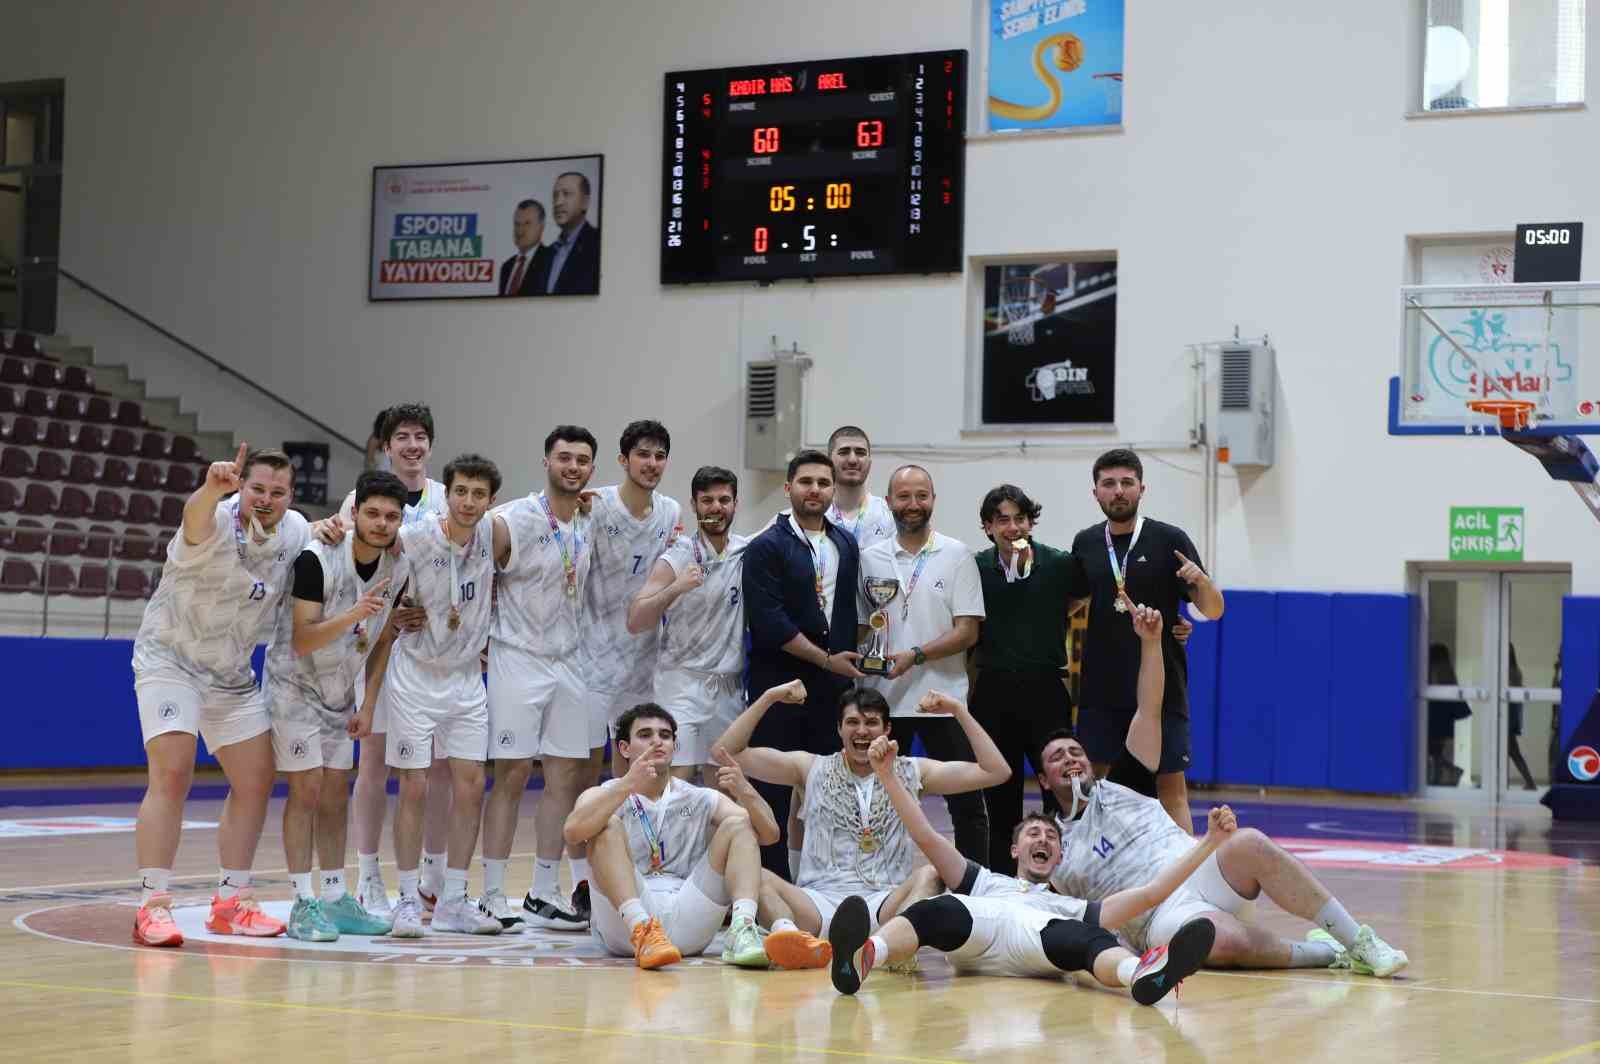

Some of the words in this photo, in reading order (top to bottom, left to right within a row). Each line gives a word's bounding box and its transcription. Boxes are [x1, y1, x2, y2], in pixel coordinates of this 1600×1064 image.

[914, 77, 924, 90] 2
[675, 137, 684, 149] 8
[753, 127, 779, 154] 60
[857, 121, 883, 147] 63
[913, 135, 922, 148] 8
[402, 215, 467, 235] SPORU
[755, 227, 768, 253] 0
[803, 225, 816, 251] 5
[1525, 229, 1570, 245] 05:00
[396, 239, 475, 259] TABANA
[384, 262, 492, 281] YAYIYORUZ
[632, 555, 642, 574] 7
[249, 582, 266, 600] 13
[460, 582, 475, 602] 10
[1092, 835, 1115, 859] 14
